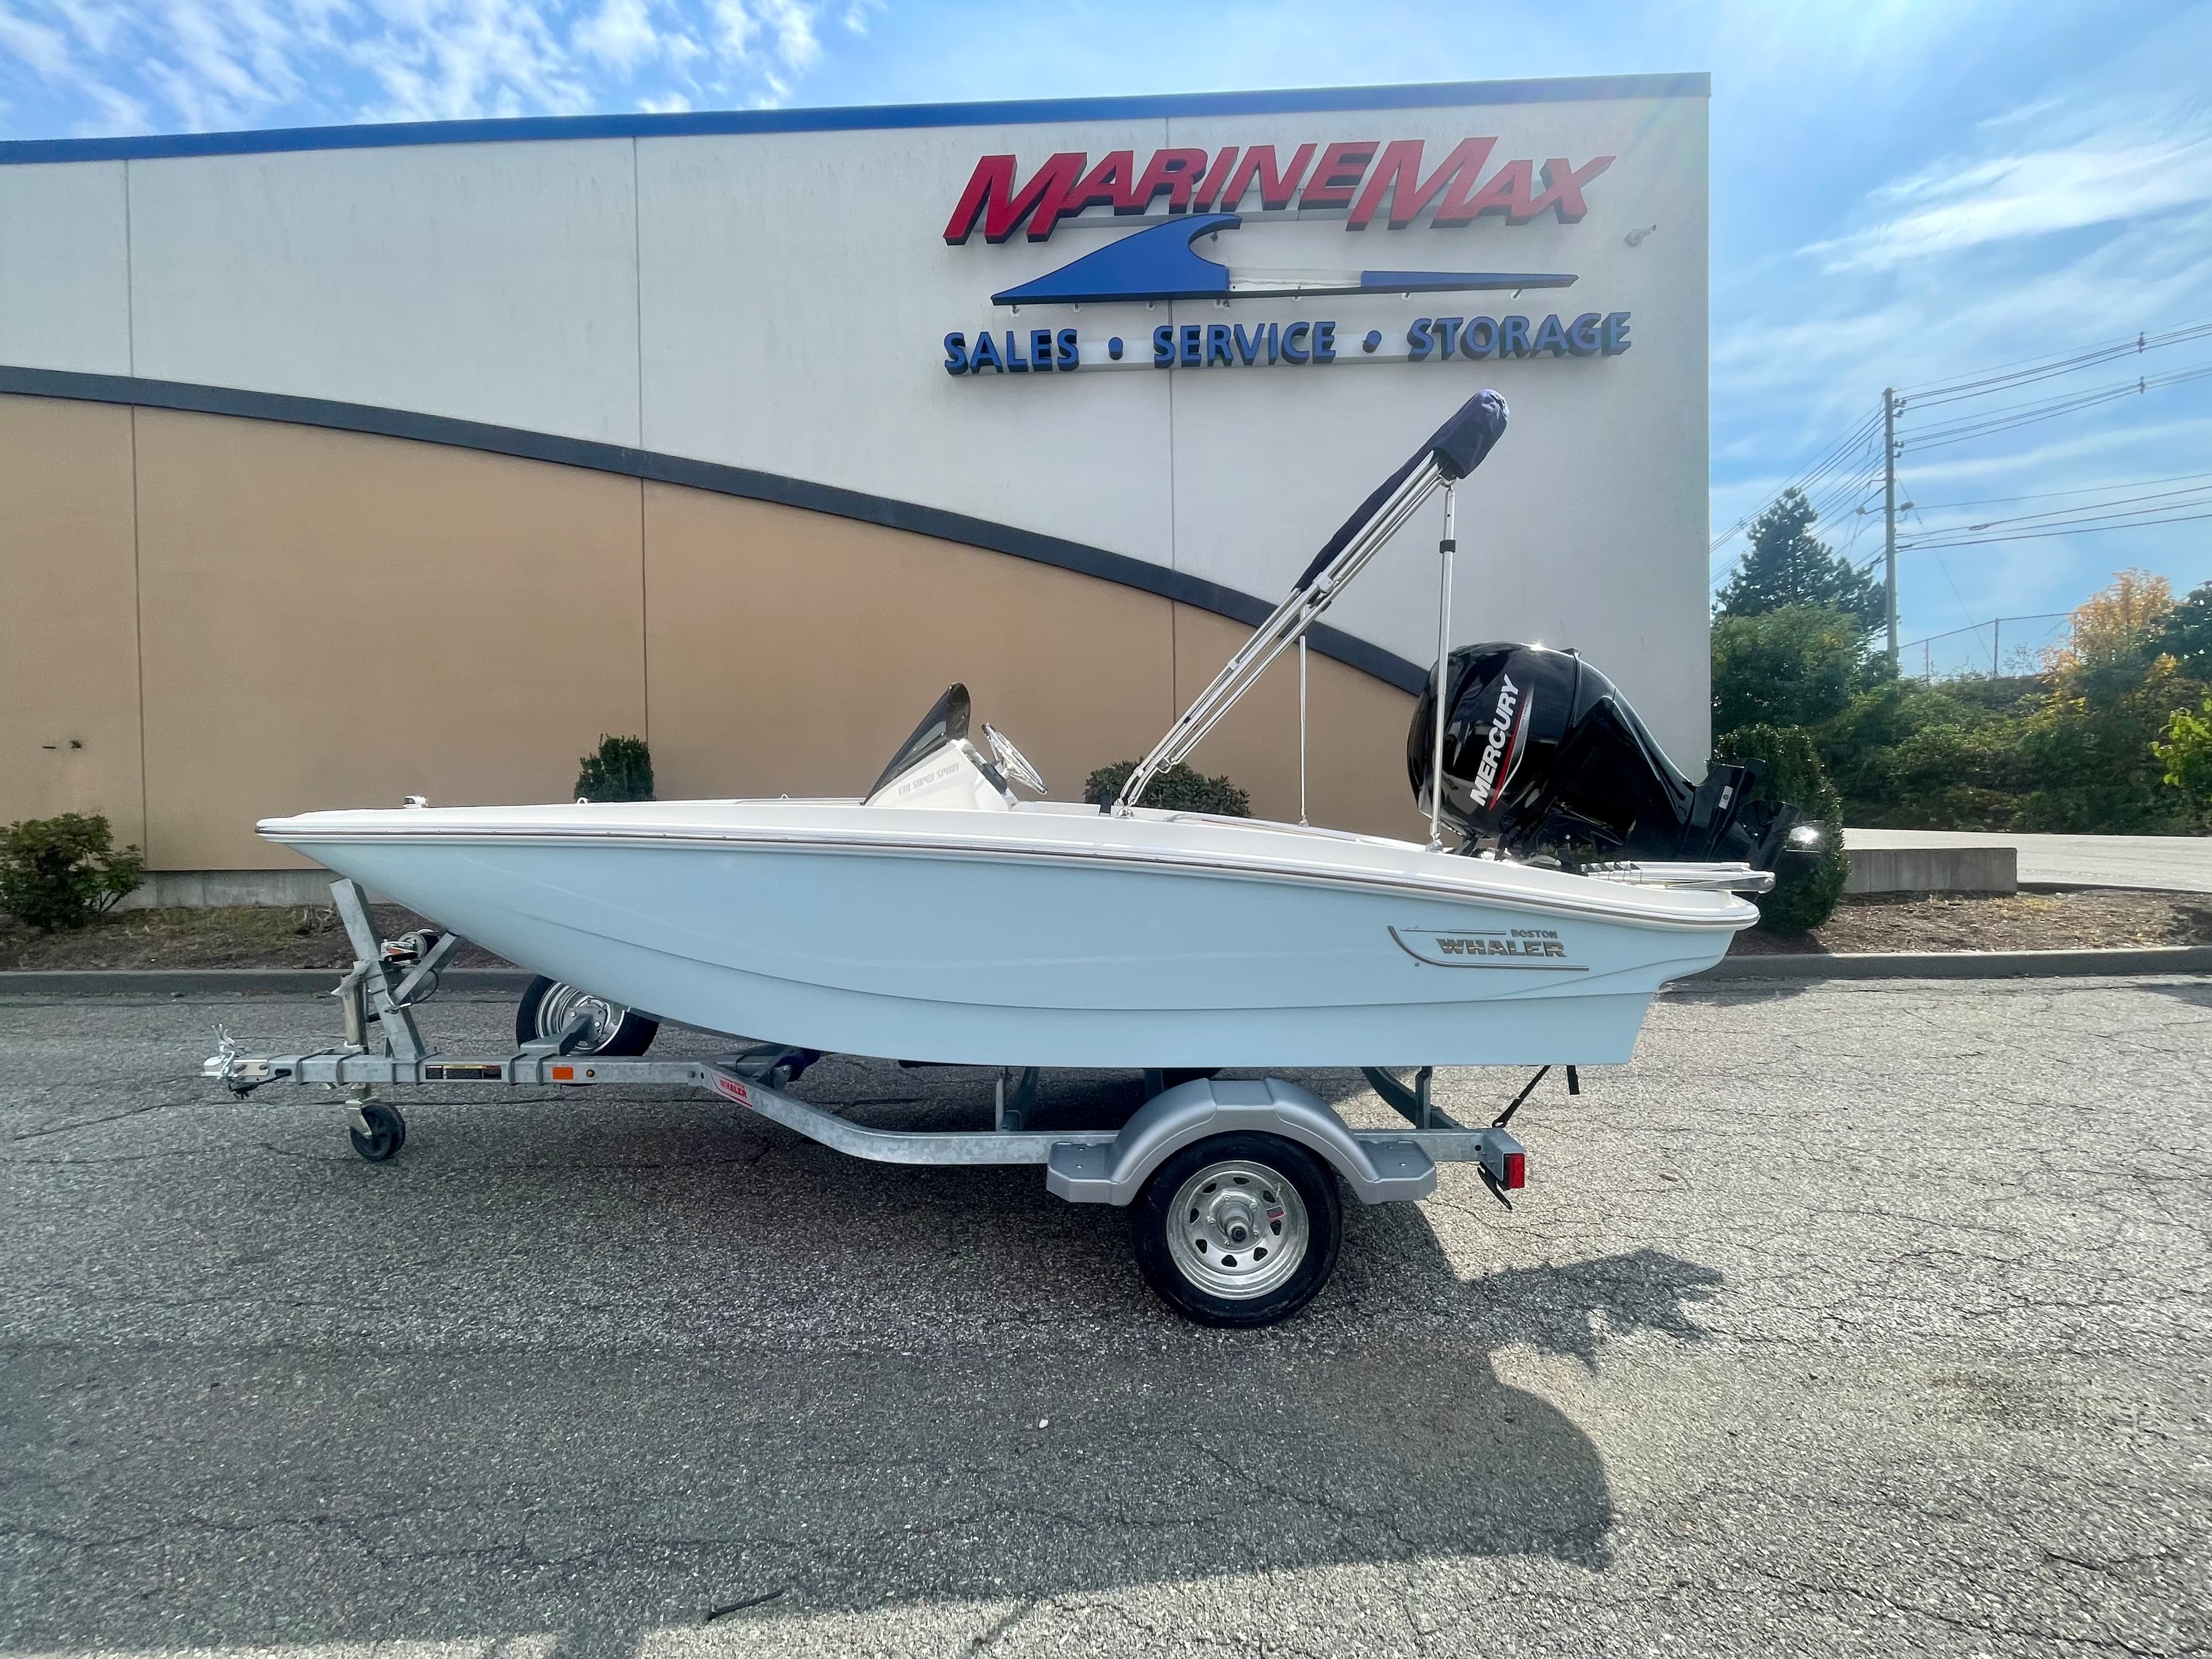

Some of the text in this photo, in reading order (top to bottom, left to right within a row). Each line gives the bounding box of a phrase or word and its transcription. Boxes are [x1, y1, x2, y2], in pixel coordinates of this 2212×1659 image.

[944, 312, 1631, 376] SALES SERVICE STORAGE
[1469, 673, 1518, 806] MERCURY
[1435, 938, 1567, 957] WHALER
[1511, 929, 1558, 939] BOSTON
